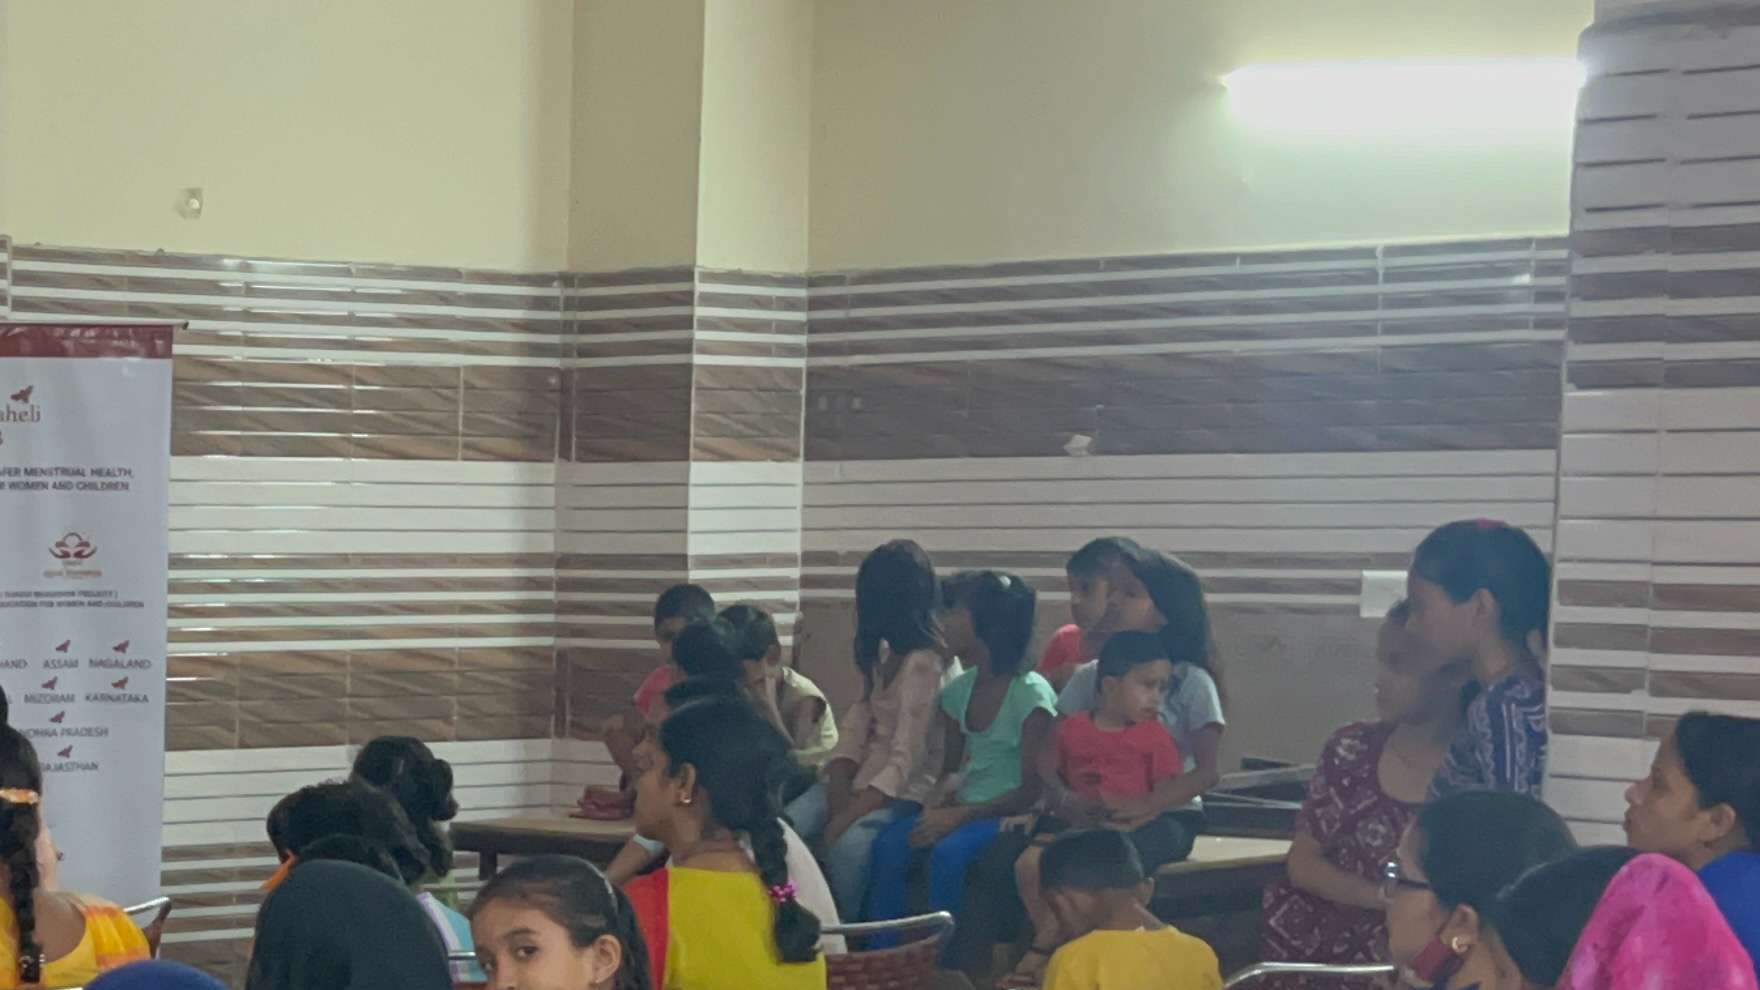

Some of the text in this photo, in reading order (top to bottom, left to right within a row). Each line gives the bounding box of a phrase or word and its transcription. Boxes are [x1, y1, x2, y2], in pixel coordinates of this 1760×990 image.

[24, 466, 86, 479] MENSTRUAL
[9, 481, 48, 492] WOMEN
[52, 481, 73, 492] AND
[76, 481, 129, 492] CHILDREN
[43, 659, 79, 669] ASSAM
[89, 659, 152, 670] NAGALAND
[24, 693, 76, 704] MIZORAM
[86, 693, 149, 704] KARNATAKA
[60, 728, 109, 738] PRADESH
